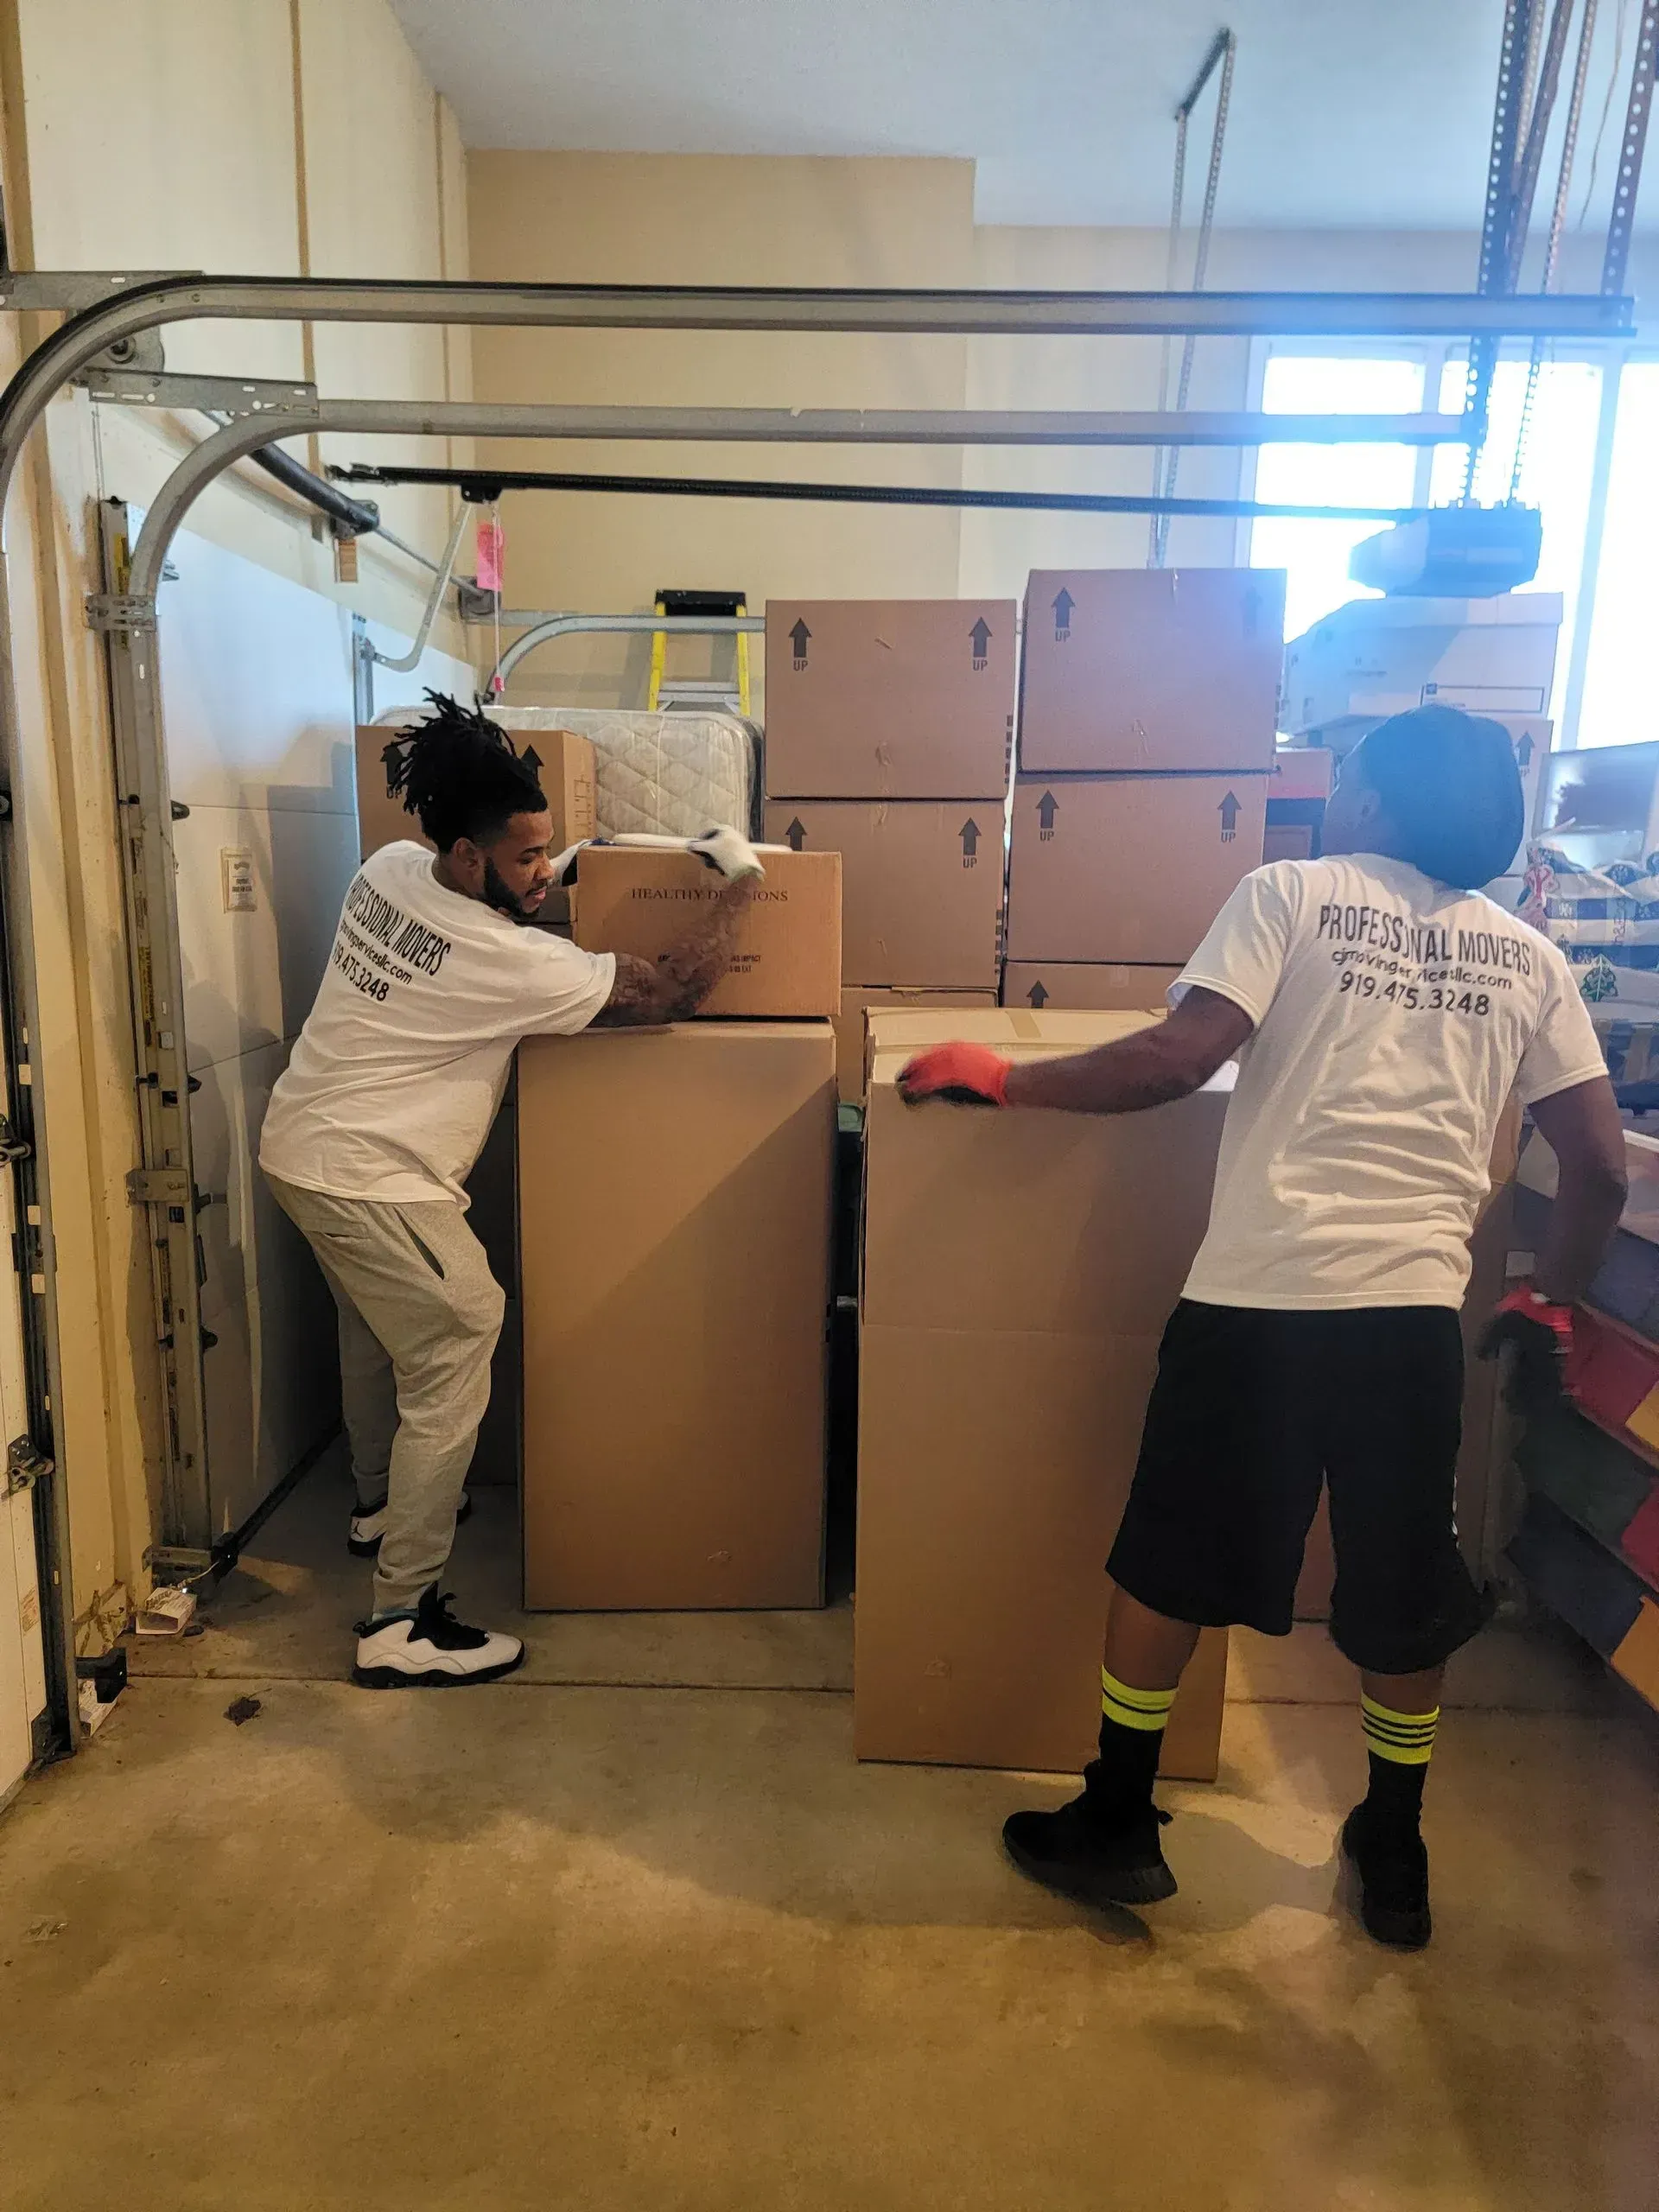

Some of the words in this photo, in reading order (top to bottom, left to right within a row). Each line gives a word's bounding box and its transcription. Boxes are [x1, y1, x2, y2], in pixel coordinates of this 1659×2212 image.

[1055, 630, 1071, 642] UP
[793, 659, 809, 671] UP
[973, 659, 988, 671] UP
[1039, 830, 1054, 842] UP
[1221, 831, 1236, 843] UP
[963, 857, 977, 868] UP
[632, 887, 703, 900] HEALTHY
[707, 888, 789, 902] DIONS
[391, 918, 452, 976] MOVERS
[1458, 929, 1531, 976] MOVERS
[1339, 970, 1490, 1016] 919.475.3248
